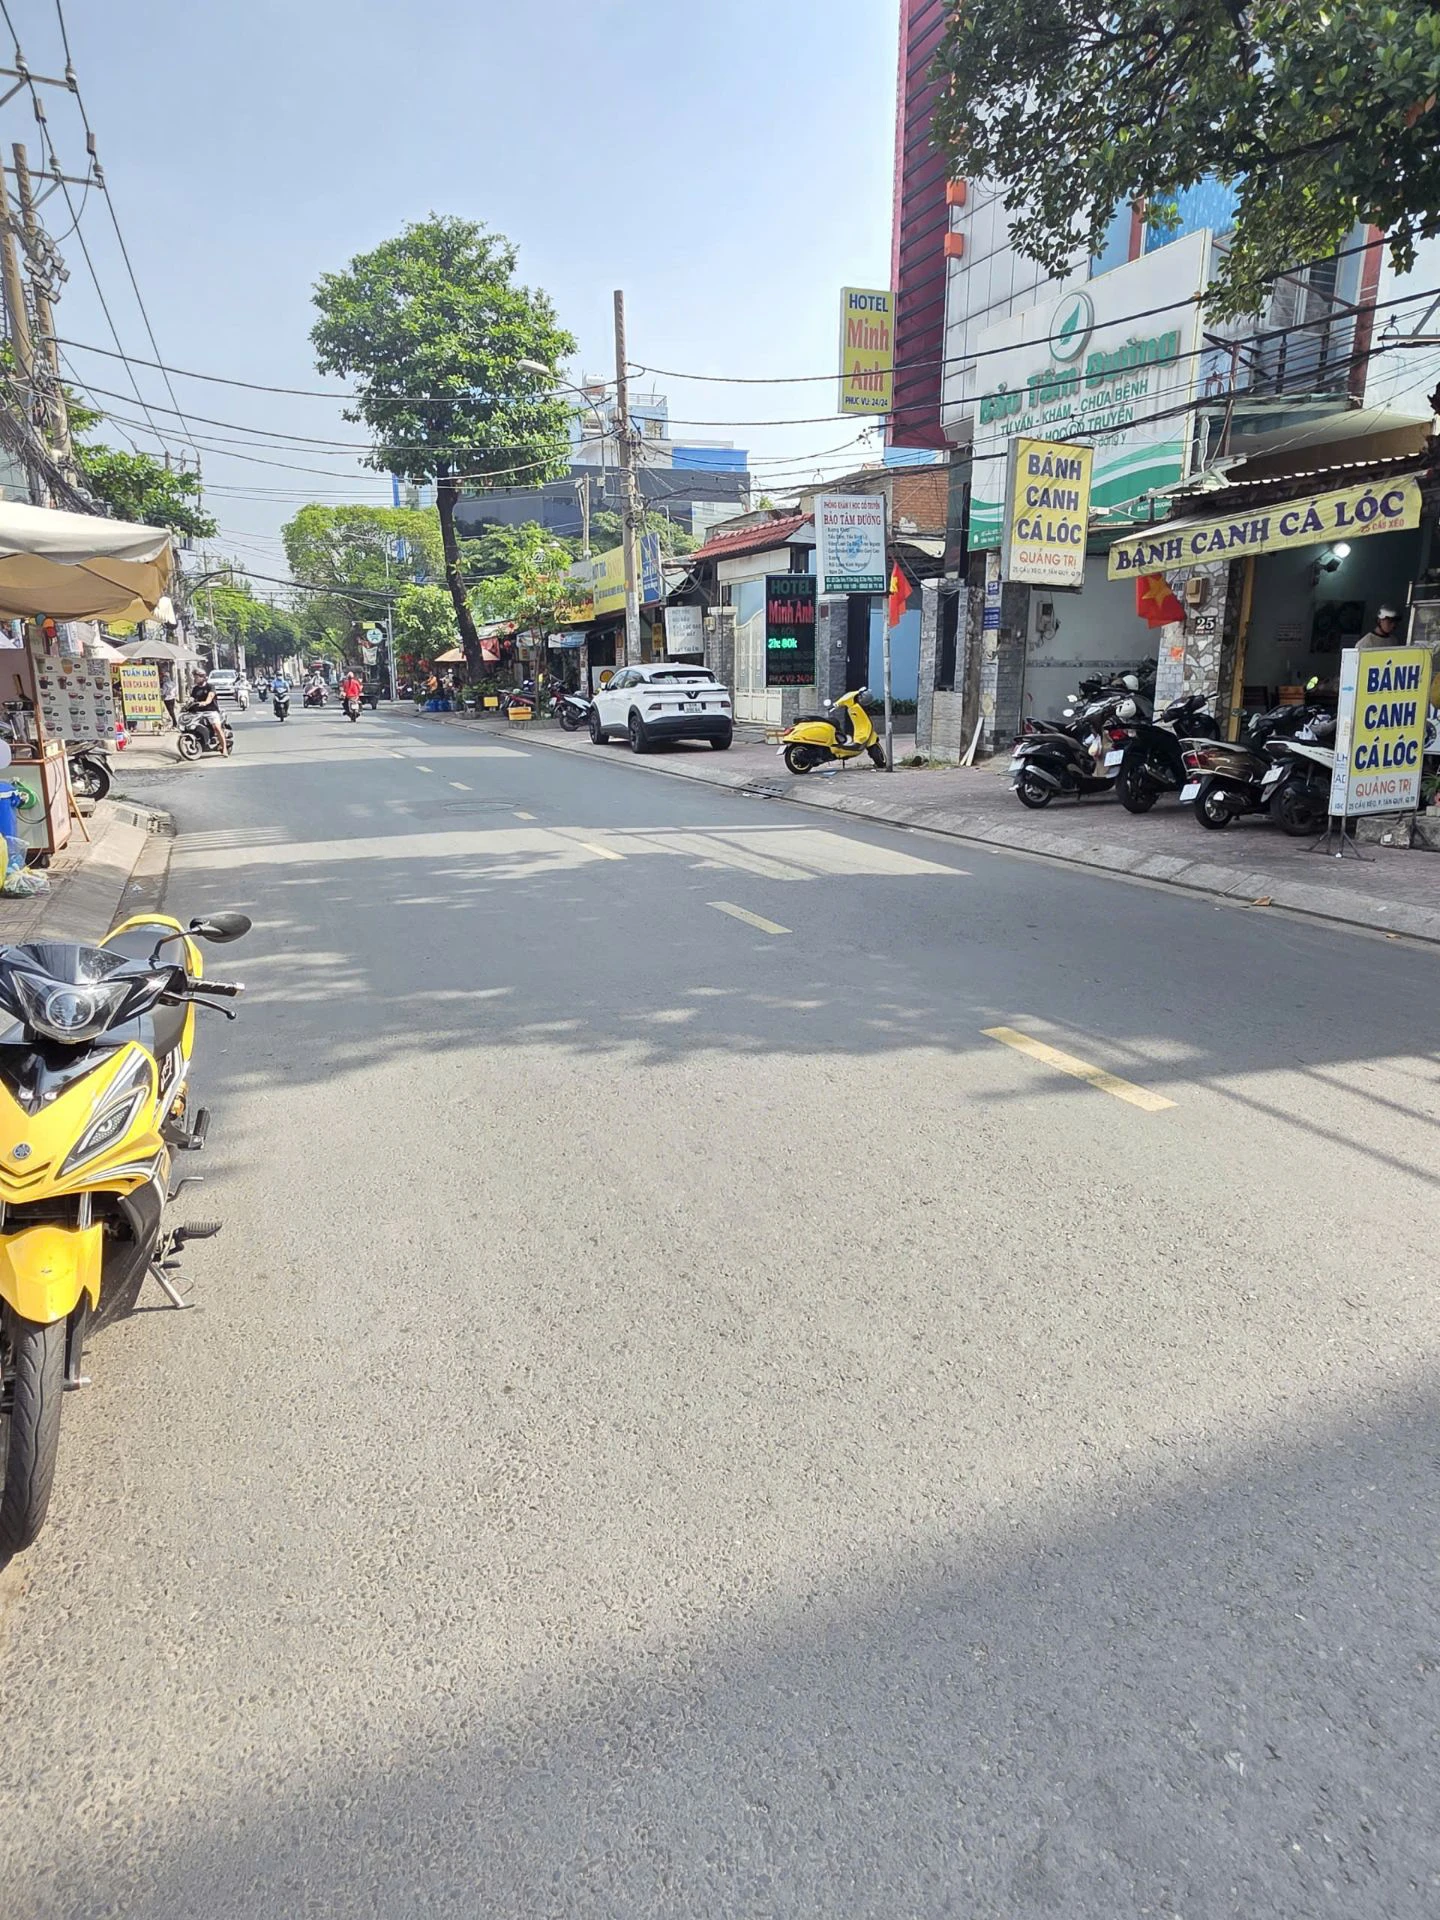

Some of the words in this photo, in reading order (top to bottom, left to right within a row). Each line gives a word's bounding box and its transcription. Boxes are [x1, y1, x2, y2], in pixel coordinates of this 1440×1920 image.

[849, 293, 889, 312] HOTEL
[848, 318, 889, 351] Minh
[851, 361, 883, 392] Anh
[1043, 402, 1072, 422] KHÁM
[1116, 378, 1148, 401] BỆNH
[1088, 405, 1133, 430] TRUYỀN
[1028, 451, 1082, 481] BÁNH
[1026, 485, 1079, 511] CANH
[823, 511, 838, 525] BẢO
[840, 512, 855, 525] TÂM
[1017, 515, 1042, 540] CÁ
[1046, 516, 1082, 544] LÓC
[1116, 538, 1184, 570] BÁNH
[1190, 517, 1270, 555] CANH
[1279, 501, 1324, 537] CÁ
[1335, 489, 1405, 527] LÓC
[1019, 548, 1061, 566] QUẢNG
[1063, 554, 1077, 569] TRỊ
[771, 580, 812, 594] HOTEL
[768, 600, 793, 624] Minh
[795, 600, 815, 624] Anh
[1196, 617, 1215, 630] 25
[1366, 659, 1421, 693] BÁNH
[1364, 702, 1417, 730] CANH
[1354, 736, 1380, 770] CÁ
[1382, 734, 1418, 767] LÓC
[1355, 776, 1396, 797] QUẢNG
[1397, 778, 1412, 795] TRỊ
